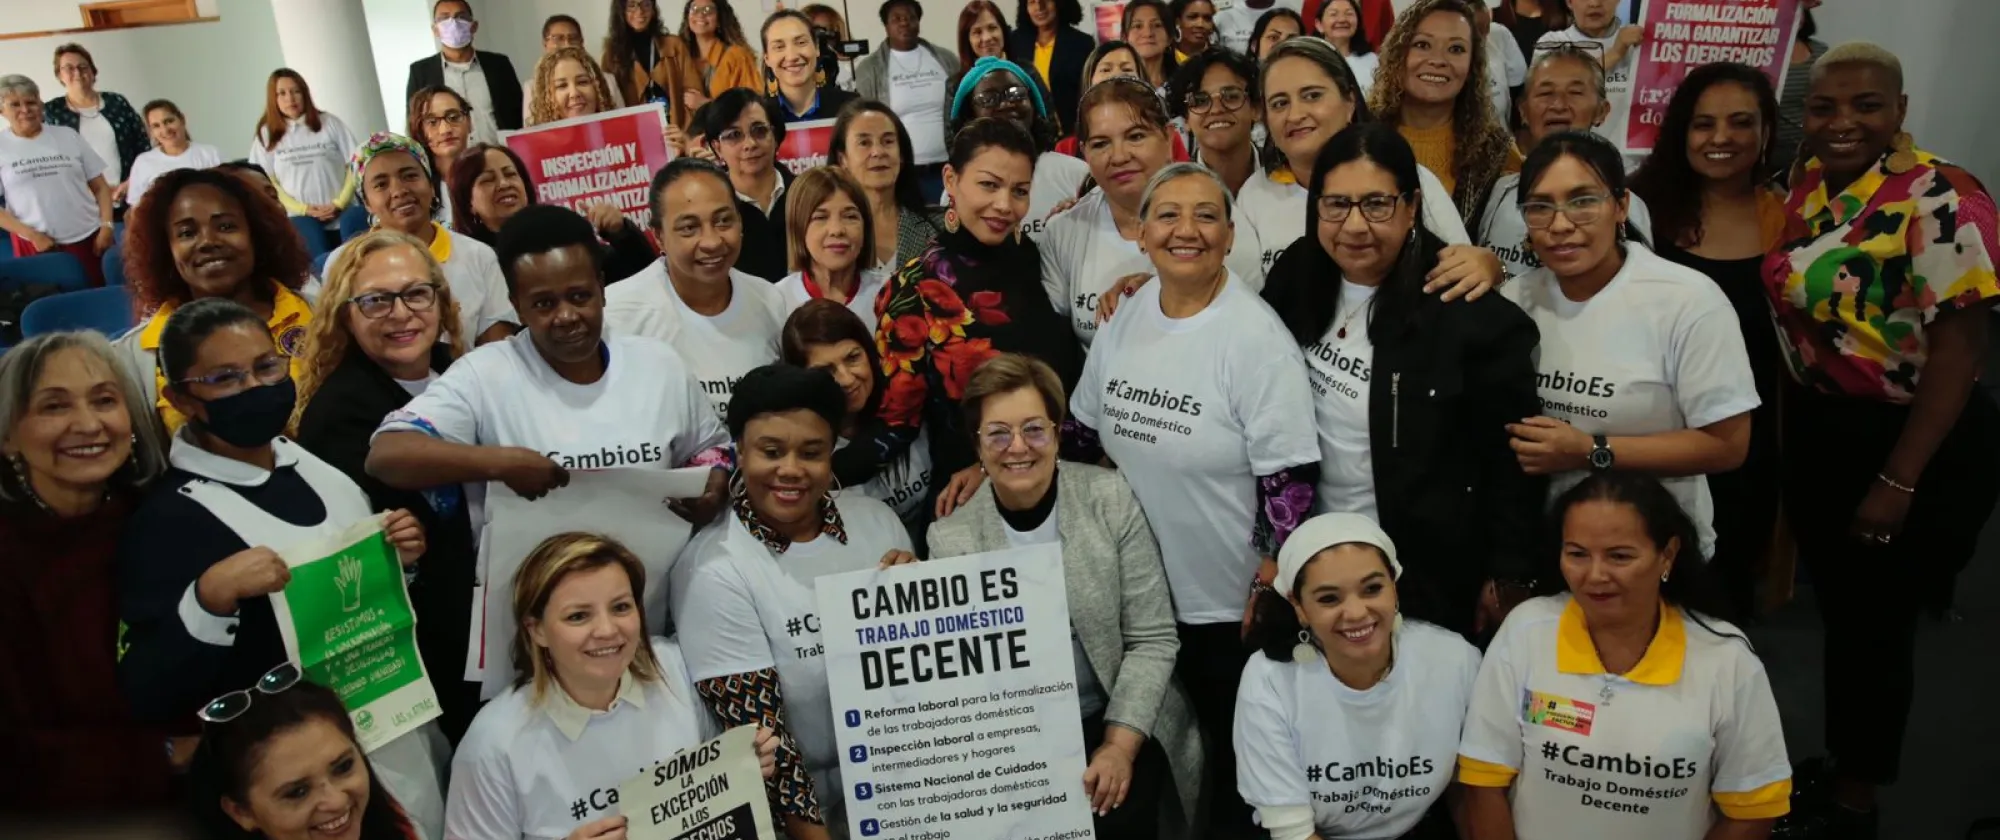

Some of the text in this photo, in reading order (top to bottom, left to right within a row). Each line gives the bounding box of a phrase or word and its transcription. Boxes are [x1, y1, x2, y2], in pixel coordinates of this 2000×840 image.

[1665, 3, 1778, 24] FORMALIZACIÓN
[1654, 22, 1780, 44] PARA GARANTIZAR
[1650, 42, 1776, 67] LOS DERECHOS
[541, 142, 637, 178] INSPECCIÓN Y
[538, 164, 650, 203] FORMALIZACIÓN
[1305, 341, 1370, 382] mbioEs
[1106, 378, 1202, 417] #CambioEs
[1536, 370, 1615, 398] mbioEs
[1114, 423, 1157, 444] Decente
[1131, 412, 1192, 436] Doméstico
[852, 567, 1019, 620] CAMBIO ES
[855, 605, 1025, 646] TRABAJO DOMÉSTICO
[794, 643, 825, 659] Trab
[860, 629, 1030, 690] DECENTE
[864, 706, 916, 721] Reforma
[918, 697, 959, 713] laboral
[961, 693, 987, 708] para
[989, 691, 1000, 703] la
[1002, 681, 1074, 700] formalización
[867, 704, 1035, 737] de las trabajadoras domésticas
[870, 739, 931, 758] Inspección
[933, 732, 974, 748] laboral
[976, 732, 985, 742] a
[987, 724, 1041, 742] empresas,
[654, 740, 721, 786] SOMOS
[872, 744, 1016, 773] intermediadores y hogares
[1306, 756, 1434, 782] #CambioEs
[1541, 741, 1696, 779] #CambioEs
[681, 773, 694, 788] LA
[874, 778, 921, 795] Sistema
[924, 771, 974, 788] Nacional
[977, 767, 991, 779] de
[994, 760, 1047, 777] Cuidados
[877, 777, 1050, 812] con las trabajadoras domésticas
[1544, 768, 1688, 799] Trabajo Doméstico
[651, 772, 729, 825] EXCEPCIÓN
[880, 815, 921, 830] Gestión
[923, 812, 938, 824] de
[940, 811, 951, 822] la
[954, 805, 984, 821] salud
[987, 807, 996, 818] y
[997, 801, 1009, 813] la
[1011, 792, 1067, 812] seguridad
[1581, 794, 1650, 815] Decente
[682, 806, 710, 831] A LOS
